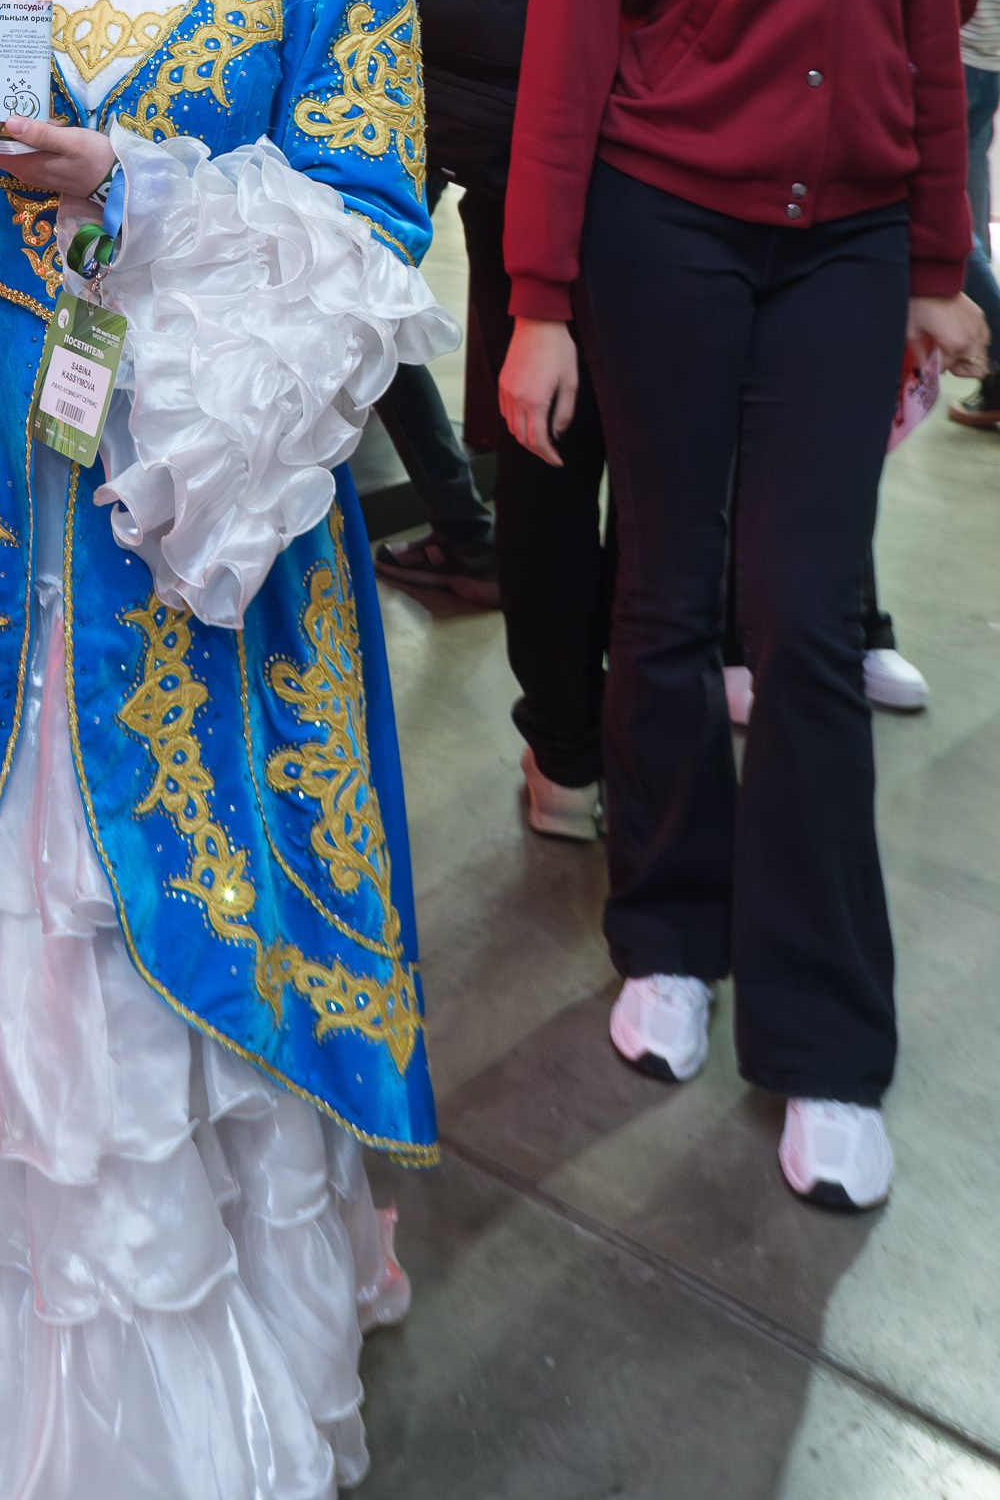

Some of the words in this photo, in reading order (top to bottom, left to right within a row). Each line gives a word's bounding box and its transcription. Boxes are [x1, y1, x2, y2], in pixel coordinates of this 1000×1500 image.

[64, 334, 105, 359] ПОСЕТИТЕЛЬ
[71, 361, 92, 377] SABINA
[61, 370, 95, 392] KASSYMOVA
